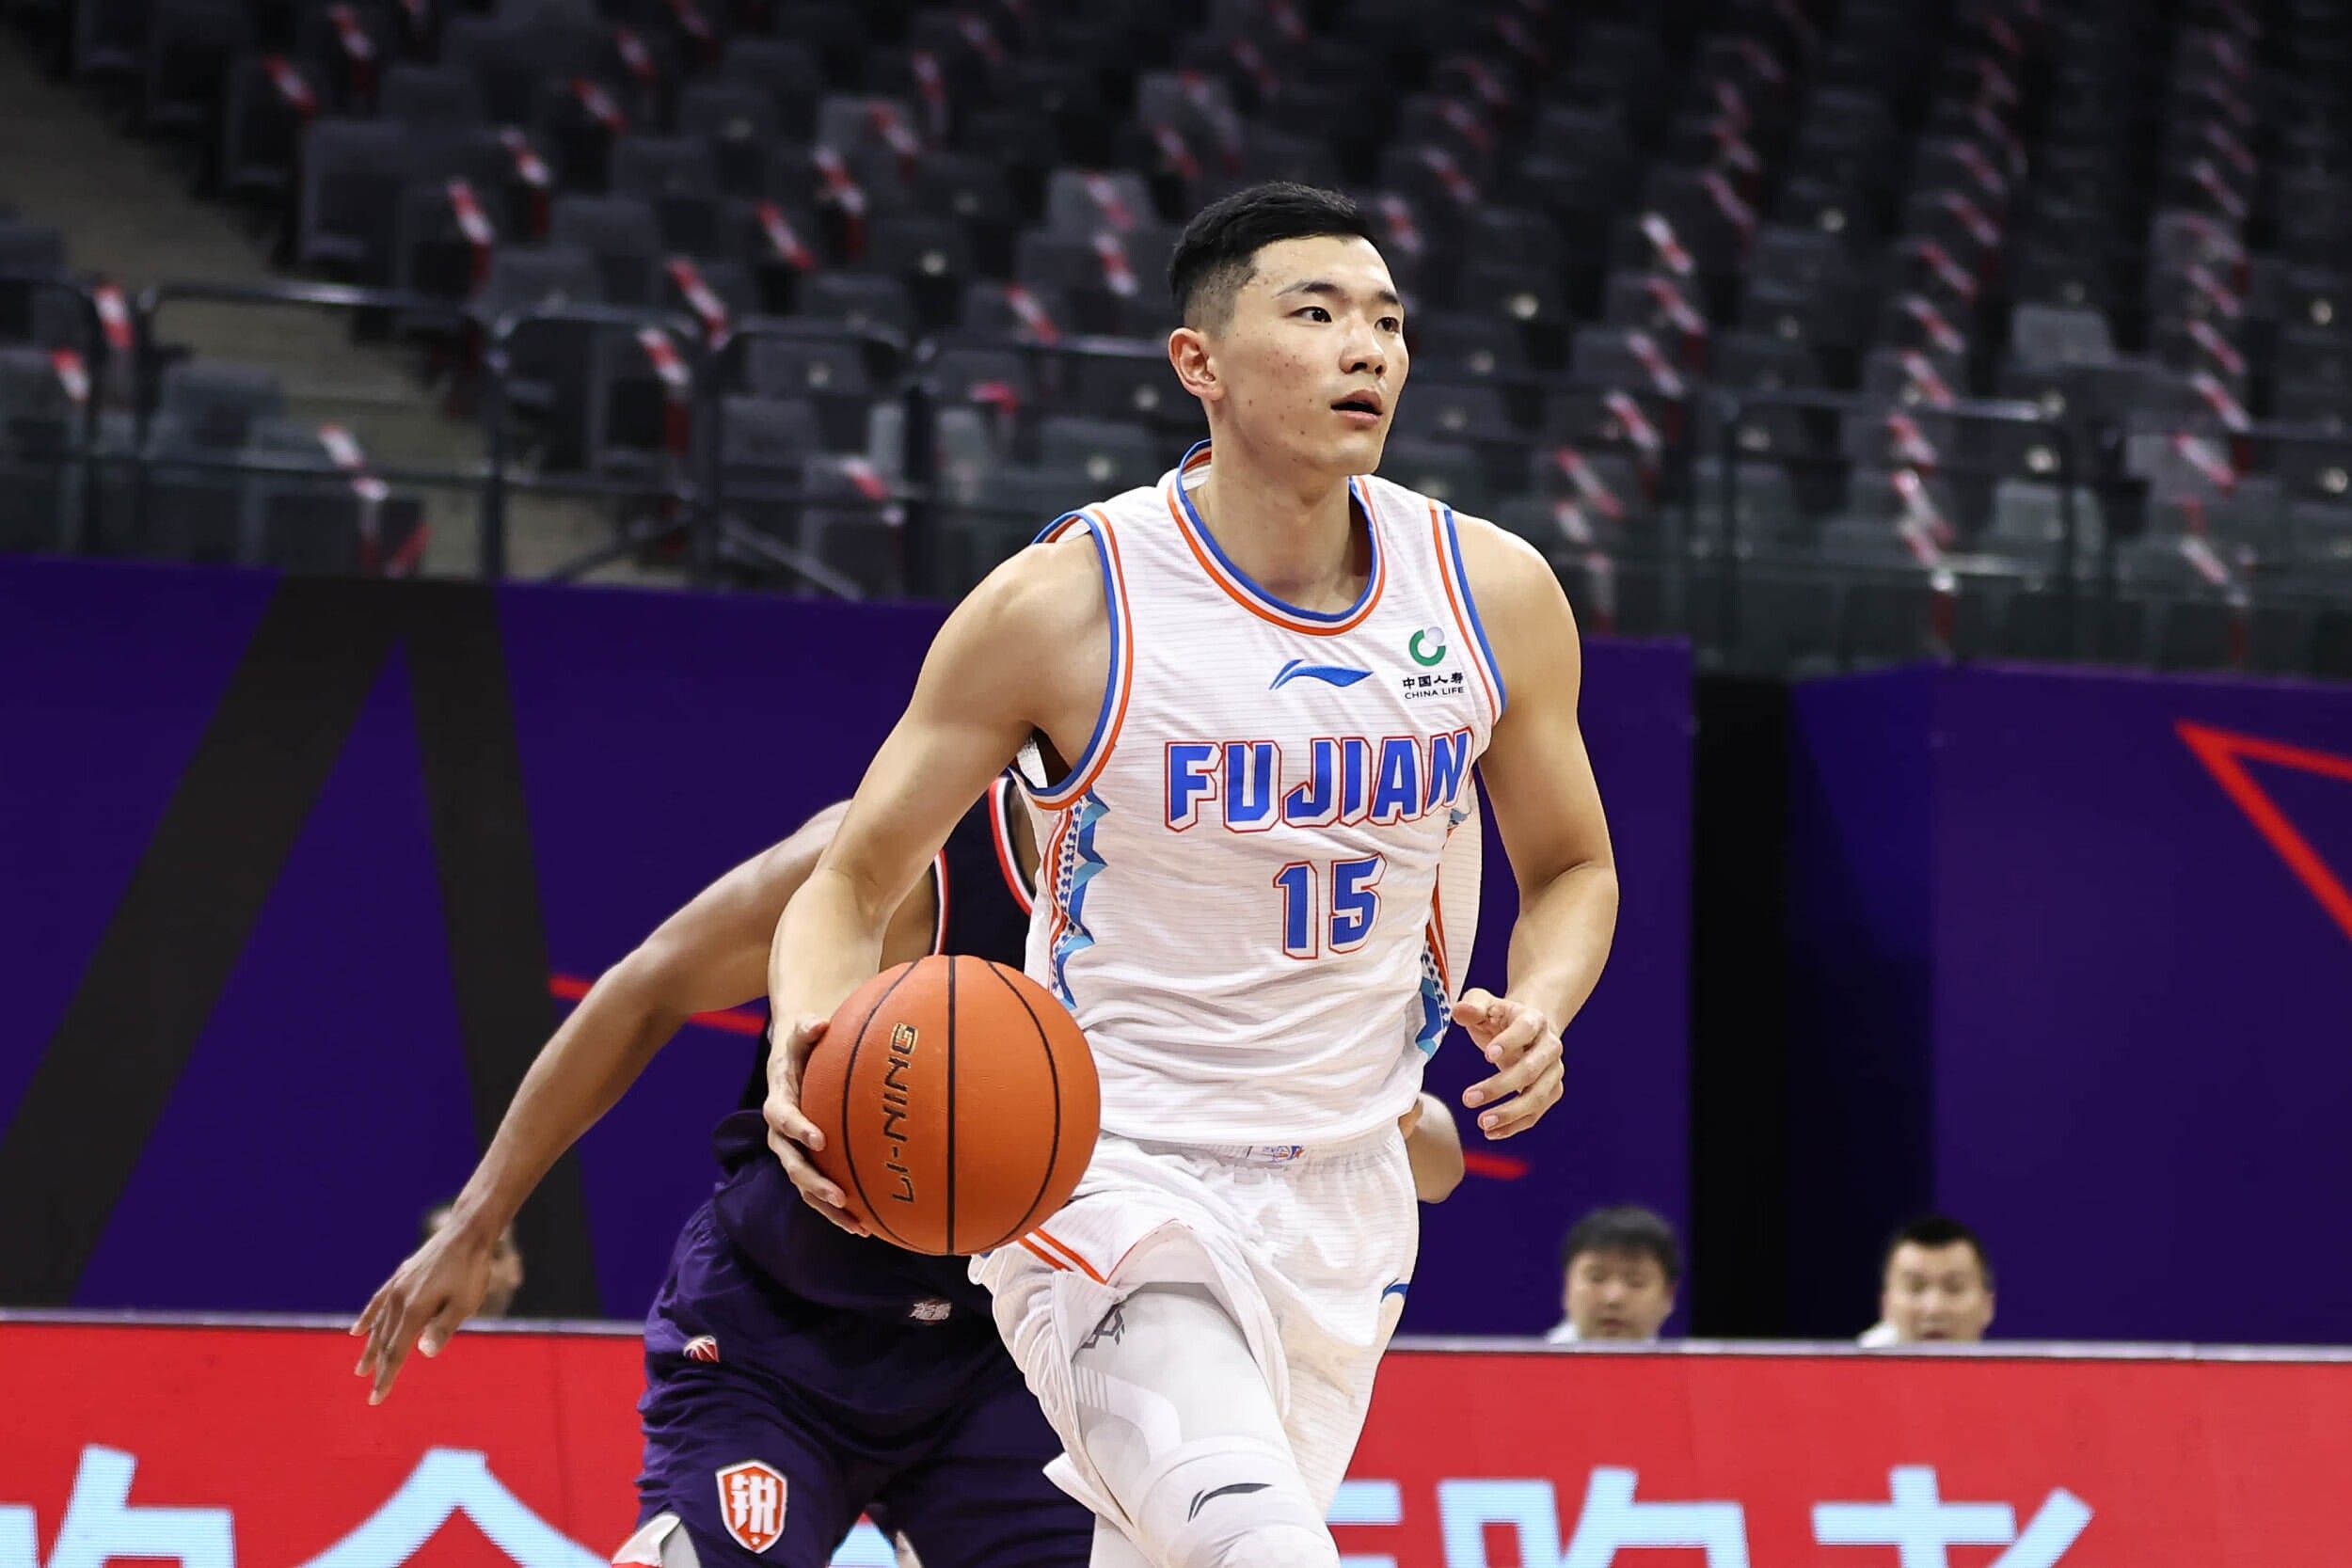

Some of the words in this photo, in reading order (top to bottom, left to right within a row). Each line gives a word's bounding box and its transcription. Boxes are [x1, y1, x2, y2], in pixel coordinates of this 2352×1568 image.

[1403, 672, 1463, 689] 中国人寿
[1405, 689, 1438, 699] CHINA
[1442, 687, 1464, 695] LIFE
[1164, 725, 1475, 832] FUJIAN
[1272, 851, 1388, 960] 15
[882, 1022, 918, 1203] LI-NING
